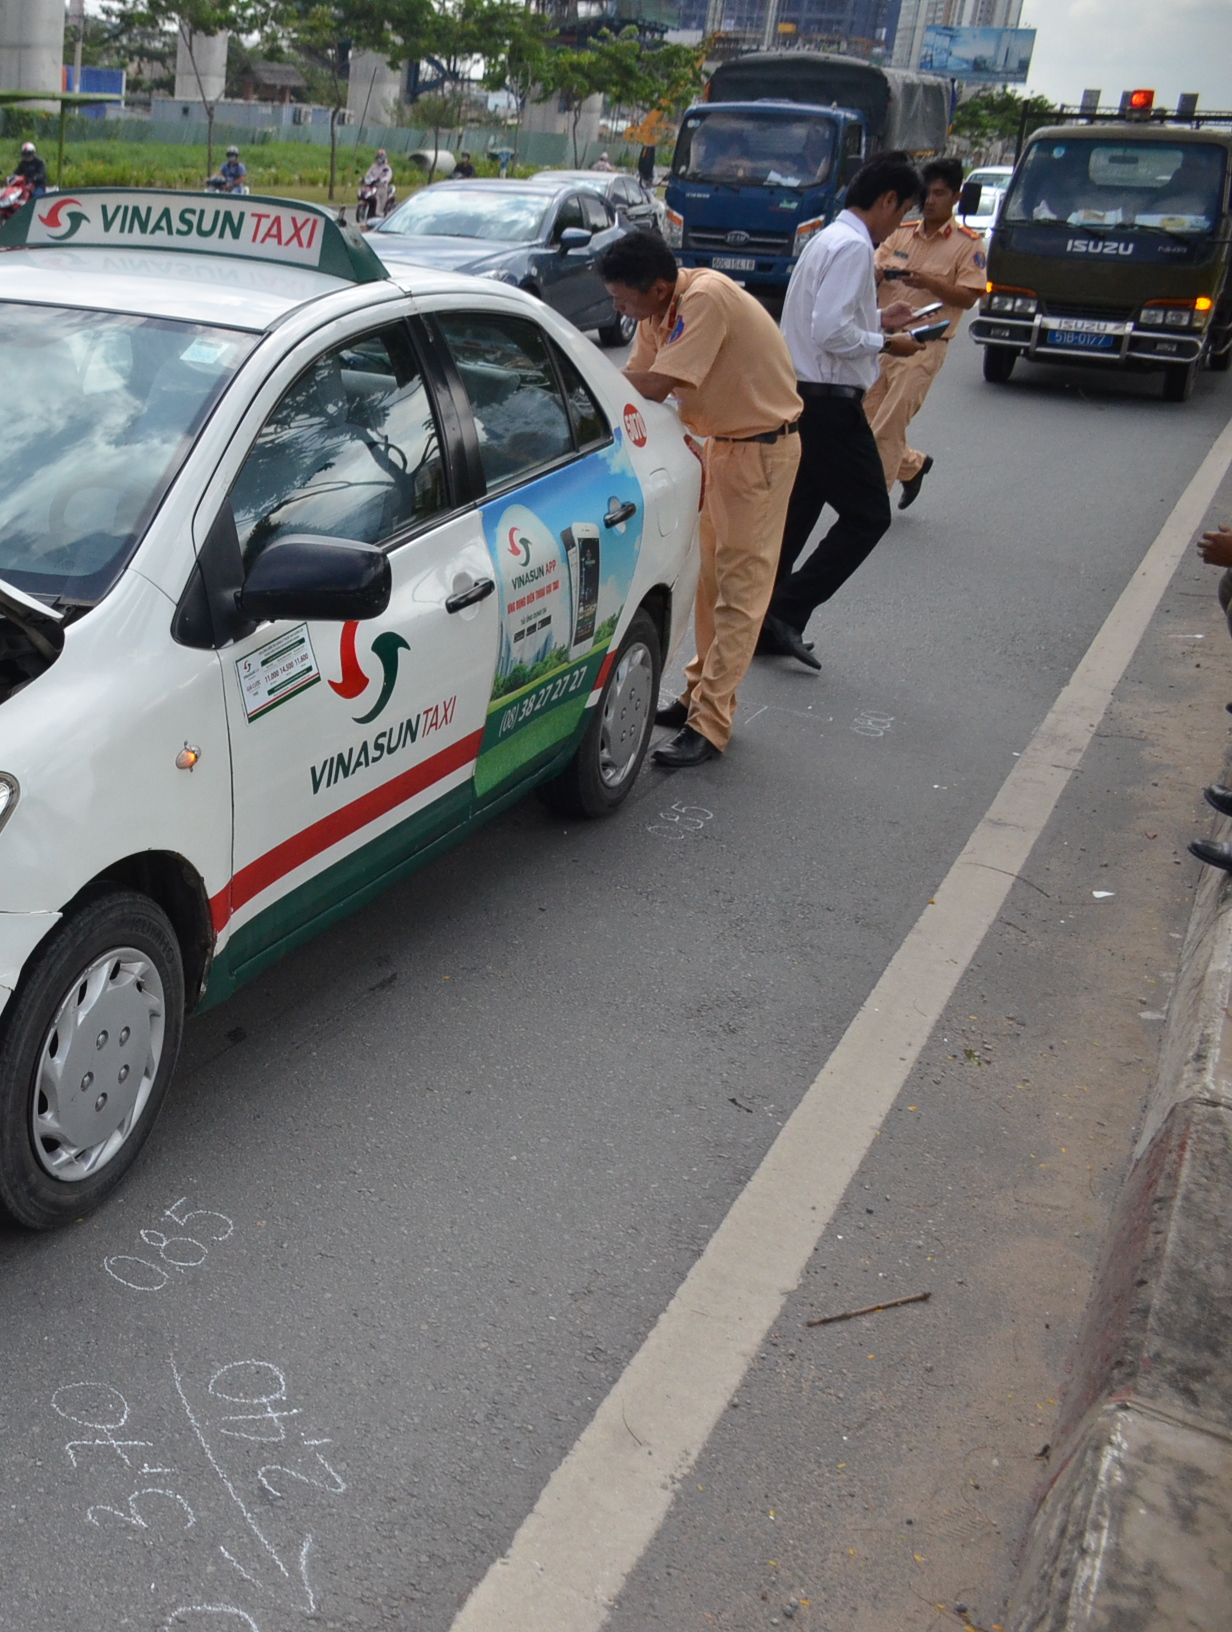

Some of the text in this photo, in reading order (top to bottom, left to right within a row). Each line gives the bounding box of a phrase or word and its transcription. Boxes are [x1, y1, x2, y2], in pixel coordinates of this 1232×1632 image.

[100, 203, 319, 249] VINASUN TAXI
[1065, 239, 1134, 256] ISUZU
[1057, 319, 1107, 332] ISUZU
[624, 412, 647, 441] 5070
[511, 560, 557, 590] VINASUN APP
[518, 694, 536, 722] 38
[534, 683, 554, 711] 27
[550, 674, 571, 701] 27
[569, 665, 588, 692] 27
[310, 695, 457, 795] VINASUN TAXI
